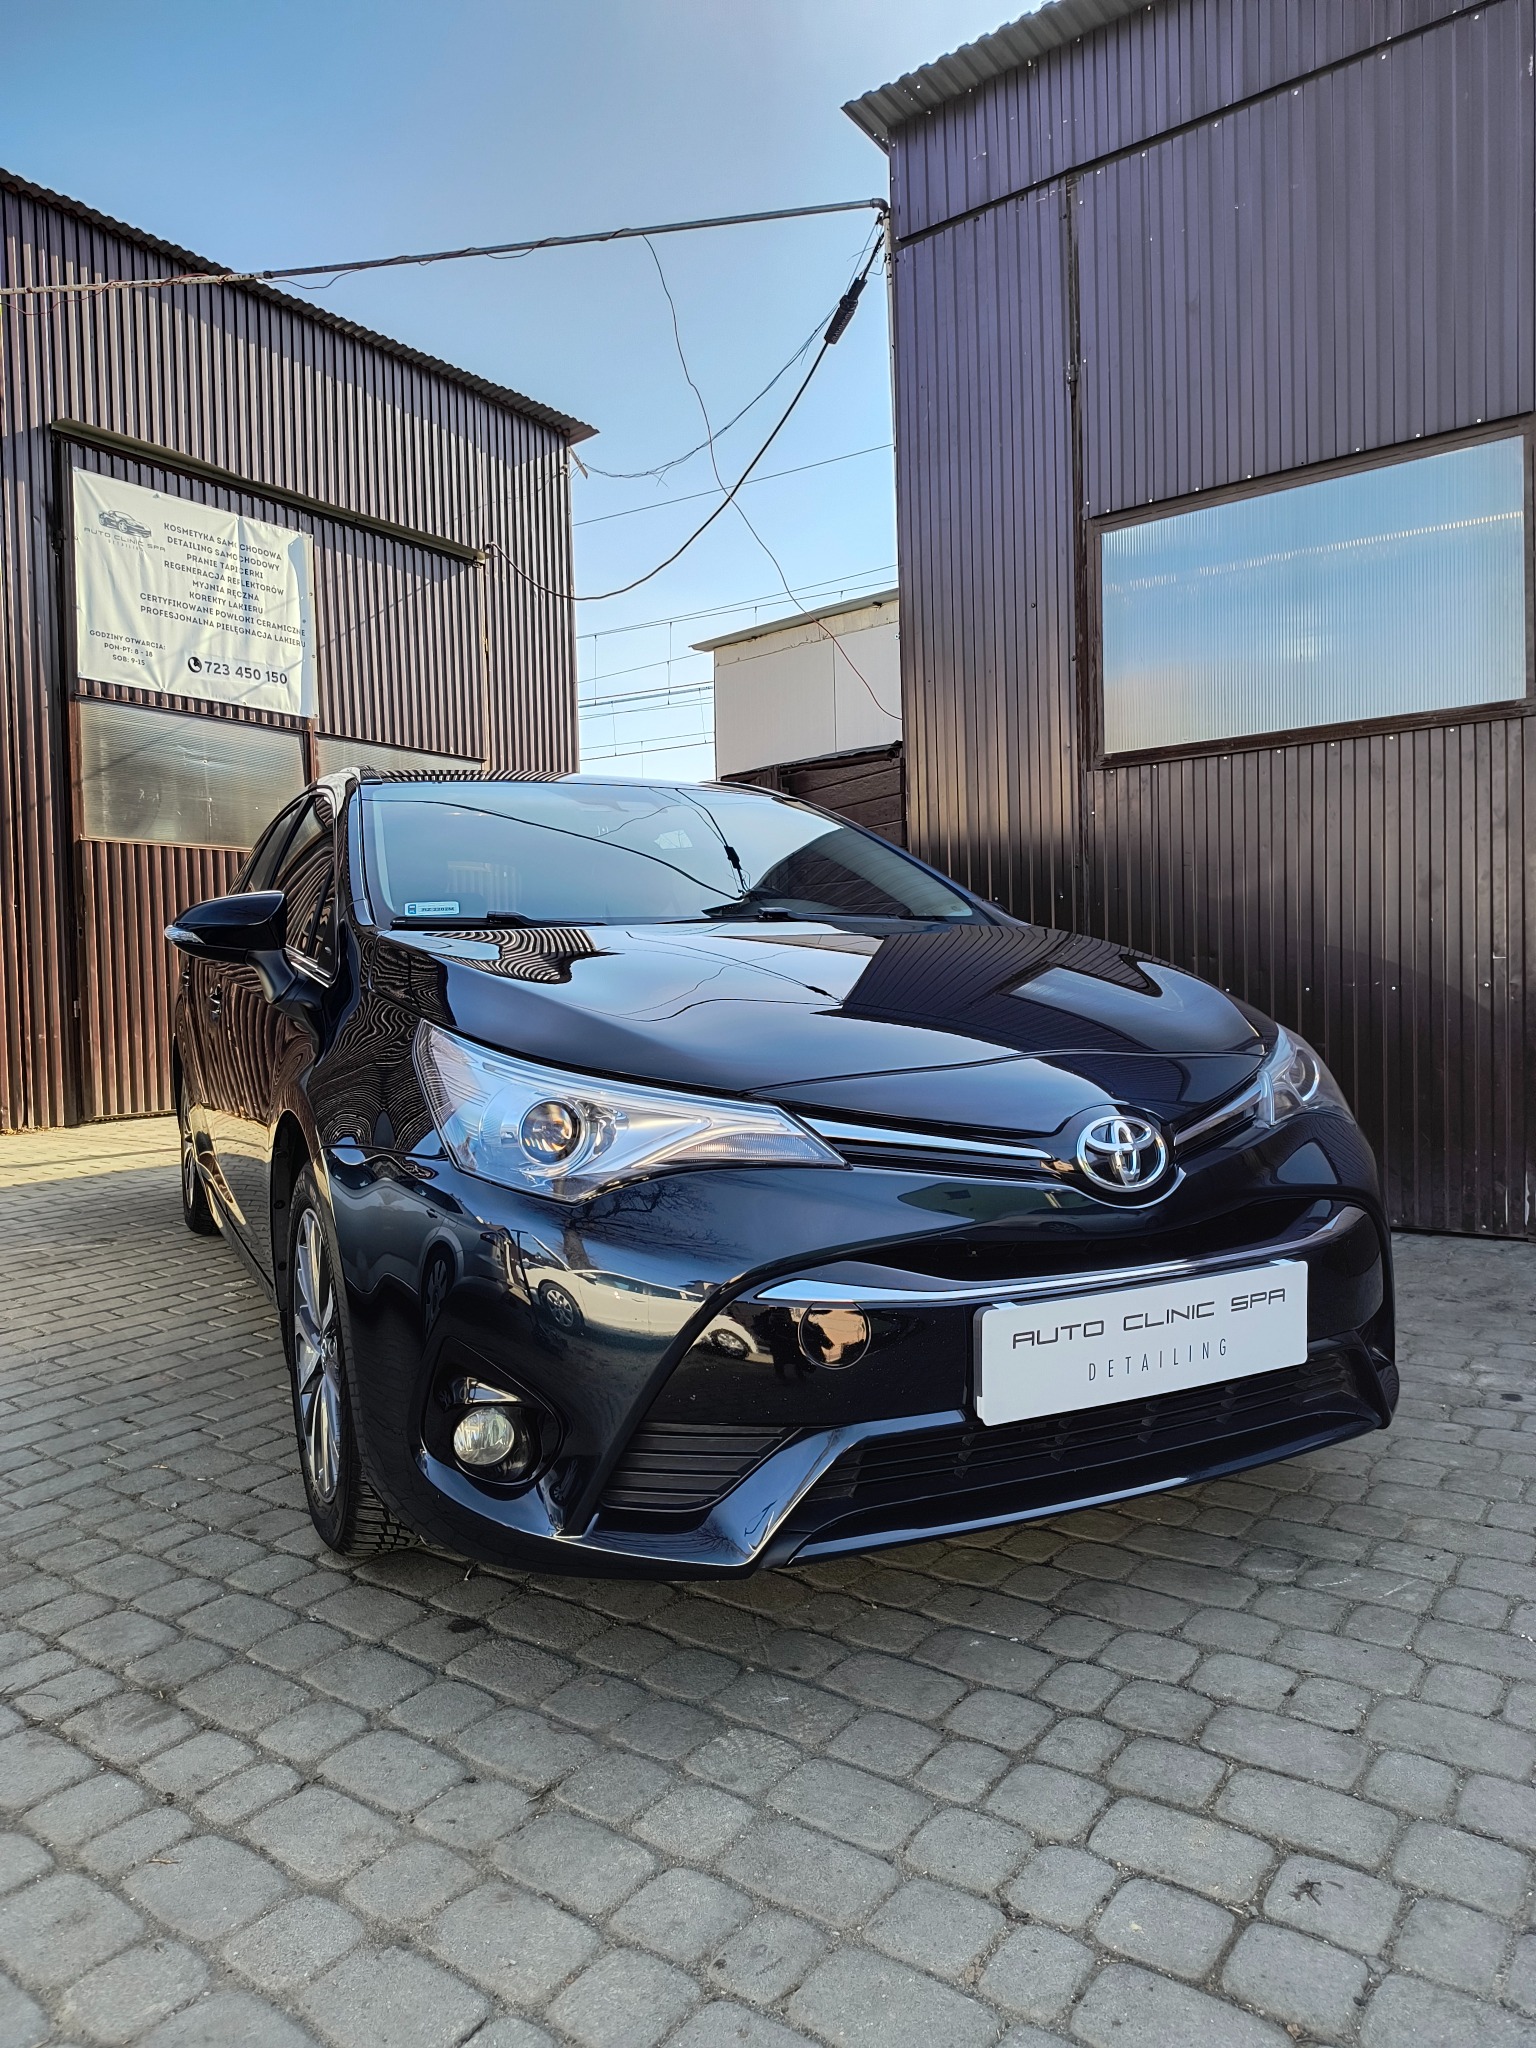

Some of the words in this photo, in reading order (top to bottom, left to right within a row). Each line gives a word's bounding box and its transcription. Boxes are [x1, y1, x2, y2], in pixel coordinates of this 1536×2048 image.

[84, 527, 111, 537] AUTO
[114, 535, 144, 546] CLINIC
[147, 544, 166, 552] SPA
[163, 523, 215, 542] KOSMETYKA
[167, 536, 213, 554] DETAILING
[215, 548, 280, 571] SAMOCHODOWY
[164, 560, 225, 582] REGENERACJA
[227, 576, 284, 595] REFLEKTORÓW
[187, 554, 218, 567] PRANIE
[220, 562, 264, 579] TAPICERKI
[189, 592, 227, 607] KOREKTY
[228, 601, 263, 614] LAKIERU
[192, 580, 225, 595] MYJNIA
[227, 588, 259, 602] RĘCZNA
[140, 593, 214, 615] CERTYFIKOWANE
[256, 618, 306, 636] CERAMICZNE
[140, 606, 214, 628] PROFESJONALNA
[216, 622, 273, 641] PIELĘGNACJA
[274, 635, 306, 648] LAKIERU
[89, 630, 123, 642] GODZINY
[125, 636, 166, 650] OTWARCIA:
[104, 643, 133, 654] PON-PT:
[112, 654, 129, 663] SOB:
[205, 660, 230, 675] 723
[235, 667, 261, 680] 450
[265, 671, 287, 684] 150
[1013, 1320, 1104, 1349] AUTO
[1124, 1301, 1215, 1331] CLINIC
[1231, 1288, 1285, 1312] SPA
[1088, 1339, 1227, 1382] DETAILING
